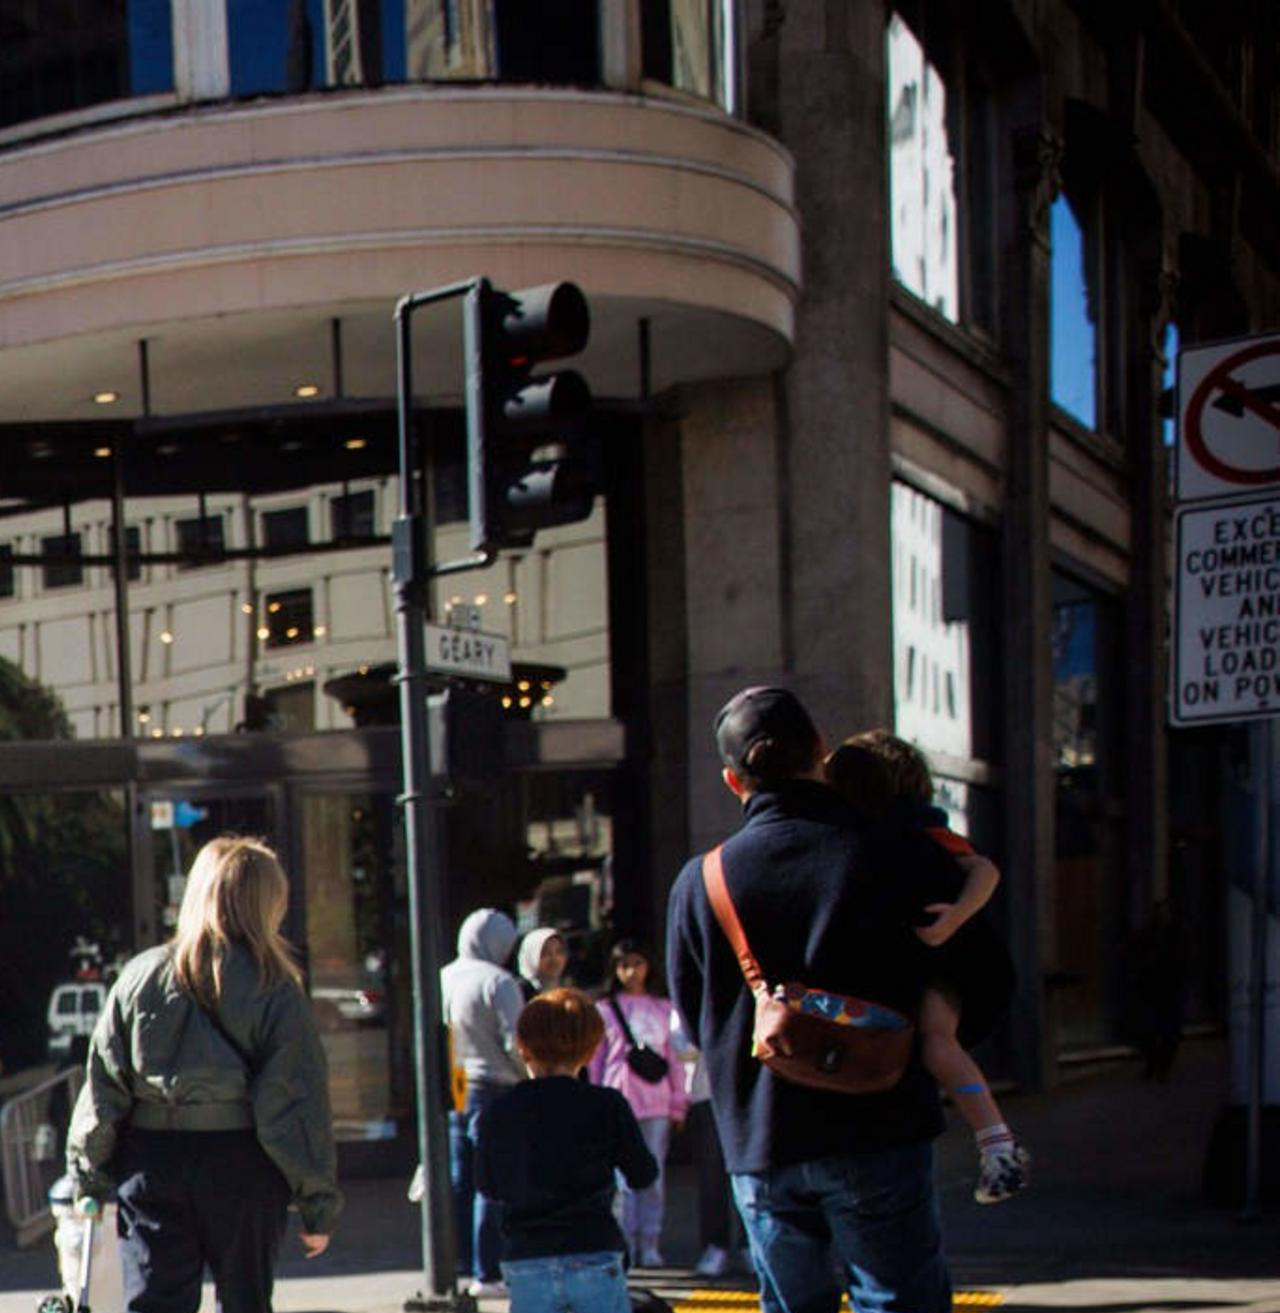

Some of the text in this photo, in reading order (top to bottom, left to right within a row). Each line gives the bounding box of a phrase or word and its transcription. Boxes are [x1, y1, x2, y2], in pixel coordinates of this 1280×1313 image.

[1214, 513, 1280, 544] EXCE
[1200, 567, 1280, 598] VEHIC
[1239, 594, 1280, 619] AN
[1200, 620, 1280, 650] VEHIC
[438, 634, 495, 668] GEARY
[1205, 647, 1279, 677] LOAD
[1184, 681, 1219, 706] ON
